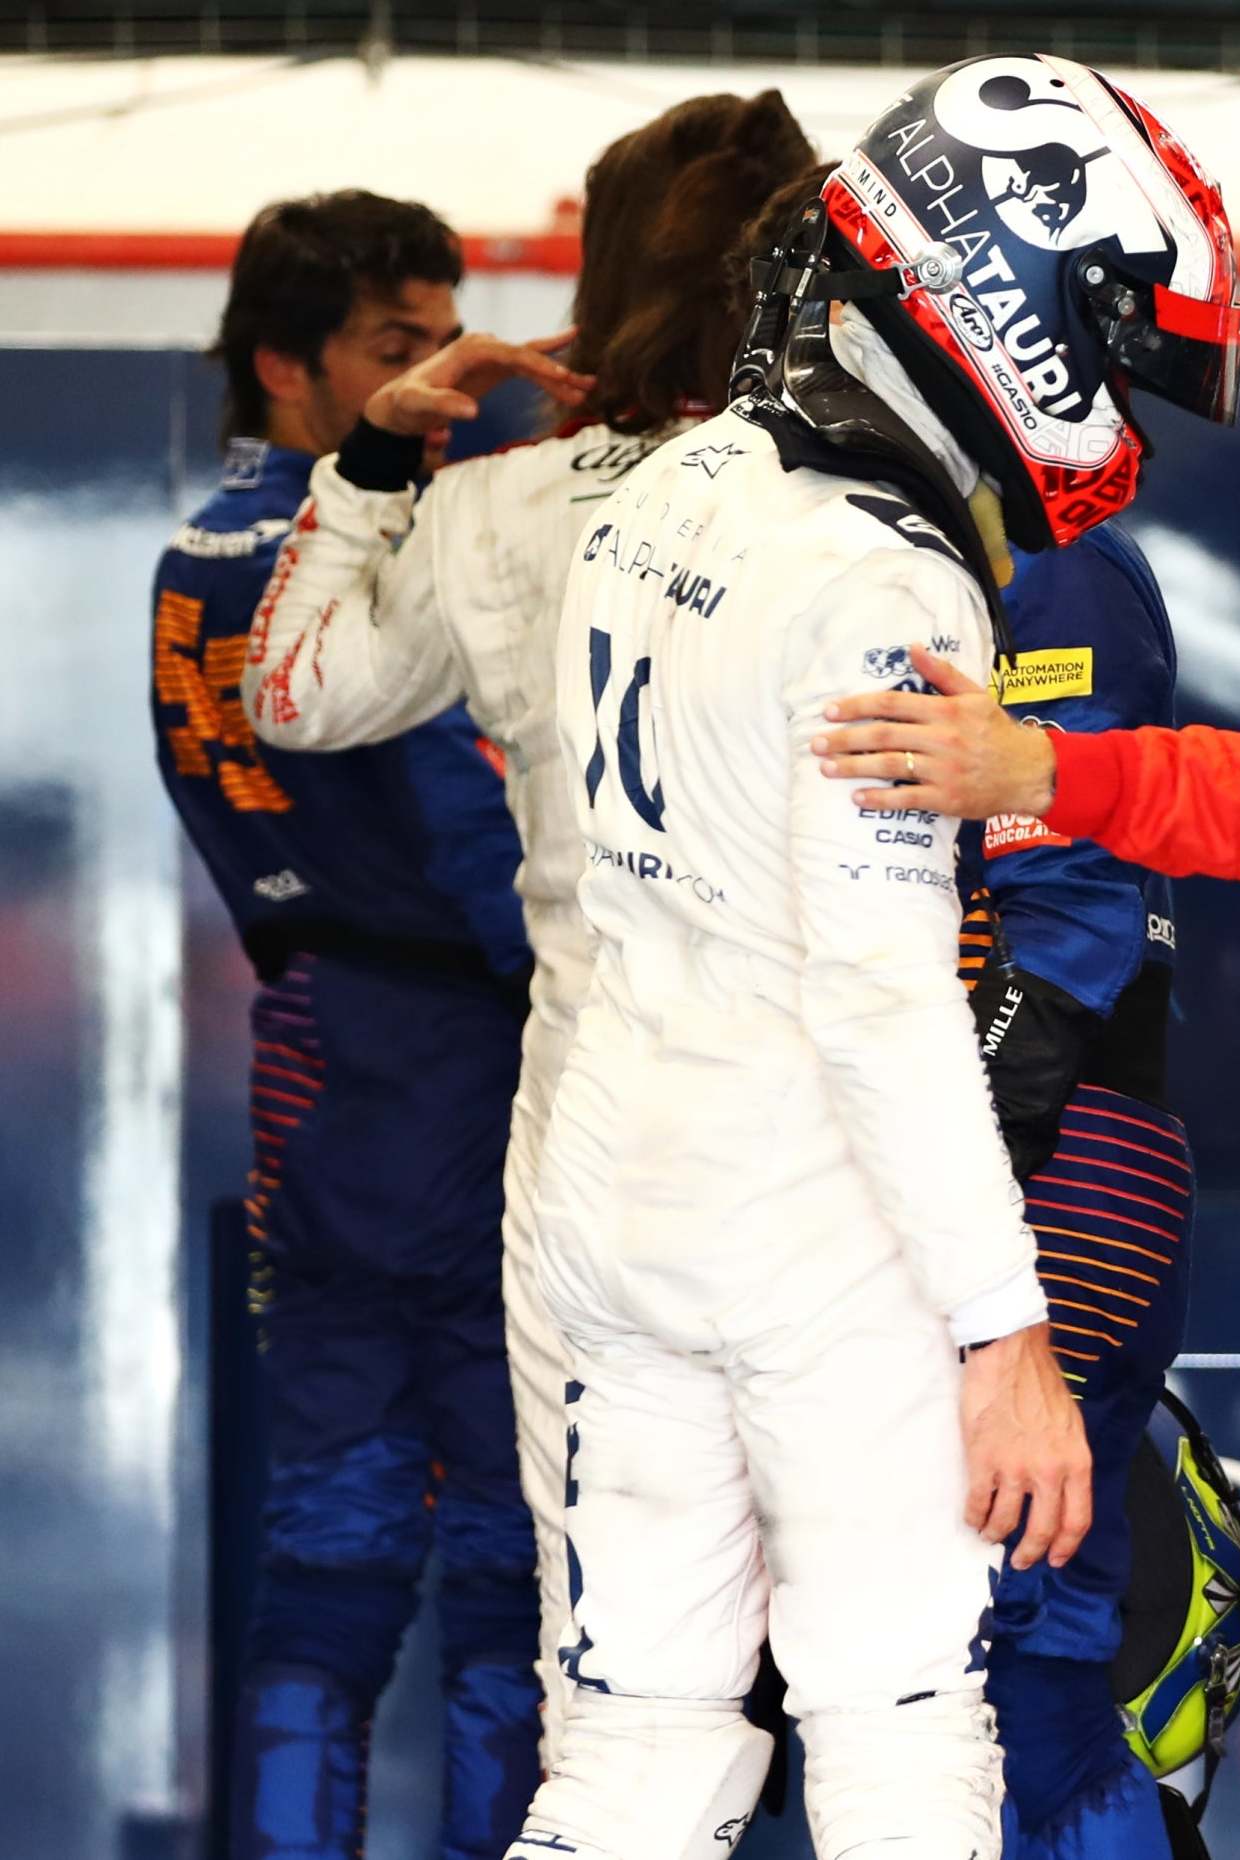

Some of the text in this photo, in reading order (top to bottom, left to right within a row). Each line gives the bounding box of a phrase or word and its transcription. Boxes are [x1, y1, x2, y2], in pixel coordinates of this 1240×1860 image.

[857, 168, 898, 218] MIND
[887, 118, 1083, 417] ALPHATAURI
[991, 362, 1038, 431] #GAS10
[1003, 661, 1085, 678] AUTOMATION
[1005, 671, 1084, 689] ANYWHERE
[875, 829, 934, 848] CASIO
[982, 986, 1024, 1057] MILLE
